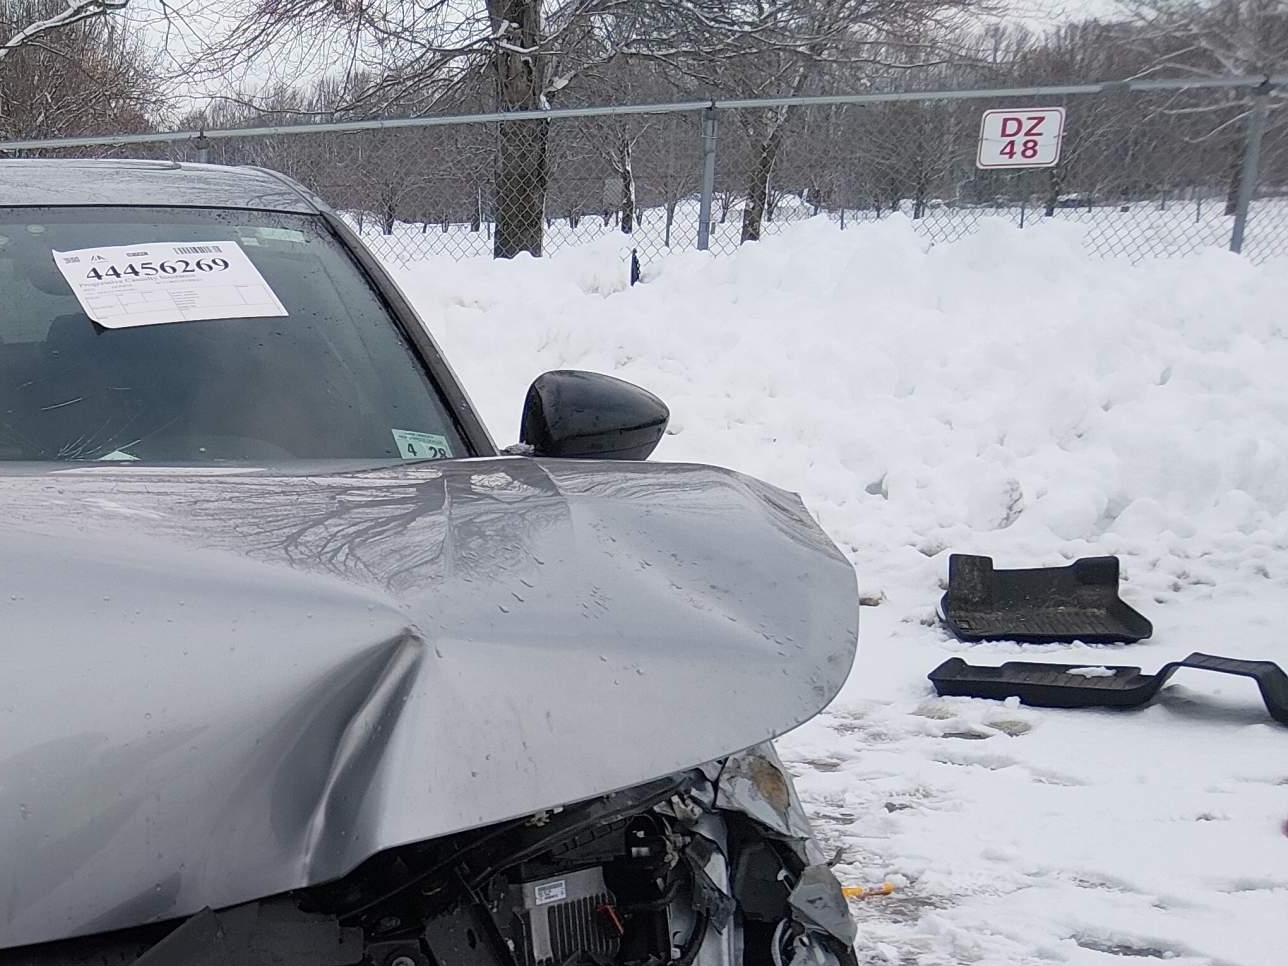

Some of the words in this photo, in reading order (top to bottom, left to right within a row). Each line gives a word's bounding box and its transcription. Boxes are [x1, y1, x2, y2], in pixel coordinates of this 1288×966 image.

[1000, 116, 1046, 138] DZ
[999, 139, 1038, 159] 48
[86, 257, 230, 280] 44456269
[407, 443, 417, 456] 4
